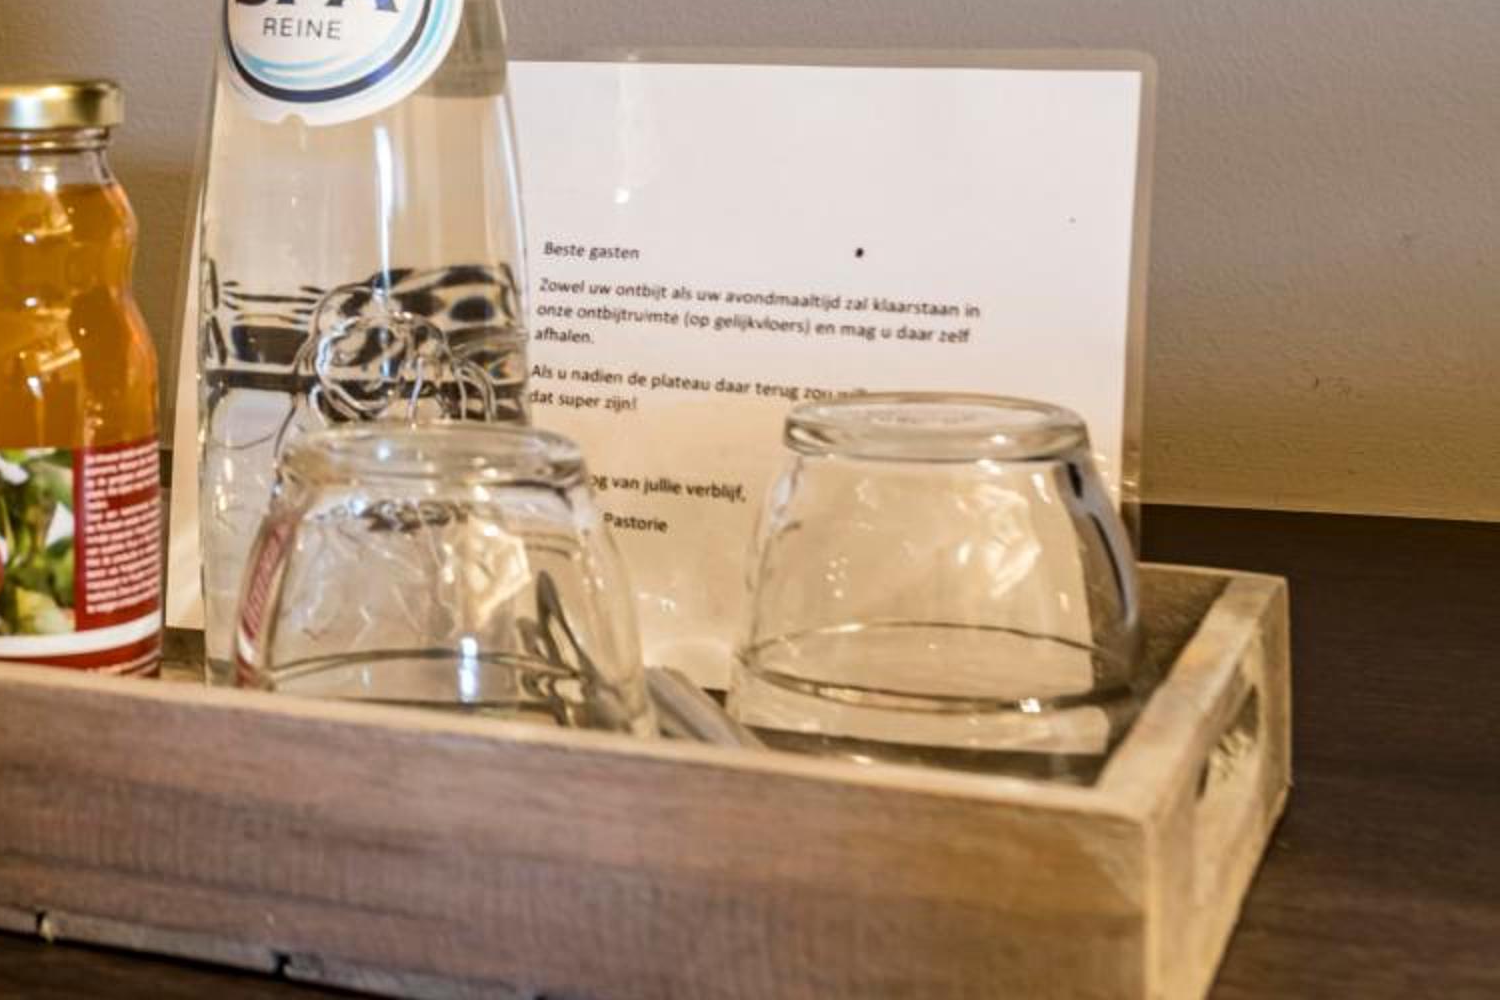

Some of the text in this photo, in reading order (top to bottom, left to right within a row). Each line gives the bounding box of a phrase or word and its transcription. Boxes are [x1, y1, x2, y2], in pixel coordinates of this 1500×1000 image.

[262, 17, 342, 40] REINE
[544, 242, 640, 261] Beste gasten
[538, 277, 980, 317] Zowel uw ontbijt als uw avondmaaltijd zal klaarstaan in
[537, 306, 572, 318] onze
[577, 307, 678, 325] ontbijtruimte
[815, 323, 835, 334] en
[840, 325, 875, 340] mag
[881, 327, 891, 338] u
[896, 325, 932, 340] daar
[938, 328, 969, 343] zelf
[531, 364, 552, 379] Als
[557, 369, 566, 380] u
[571, 368, 622, 384] nadien
[627, 371, 646, 385] de
[651, 373, 709, 390] plateau
[715, 377, 749, 393] daar
[755, 382, 798, 400] terug
[530, 388, 637, 412] dat super zijn!
[612, 477, 638, 489] van
[644, 476, 681, 494] jullie
